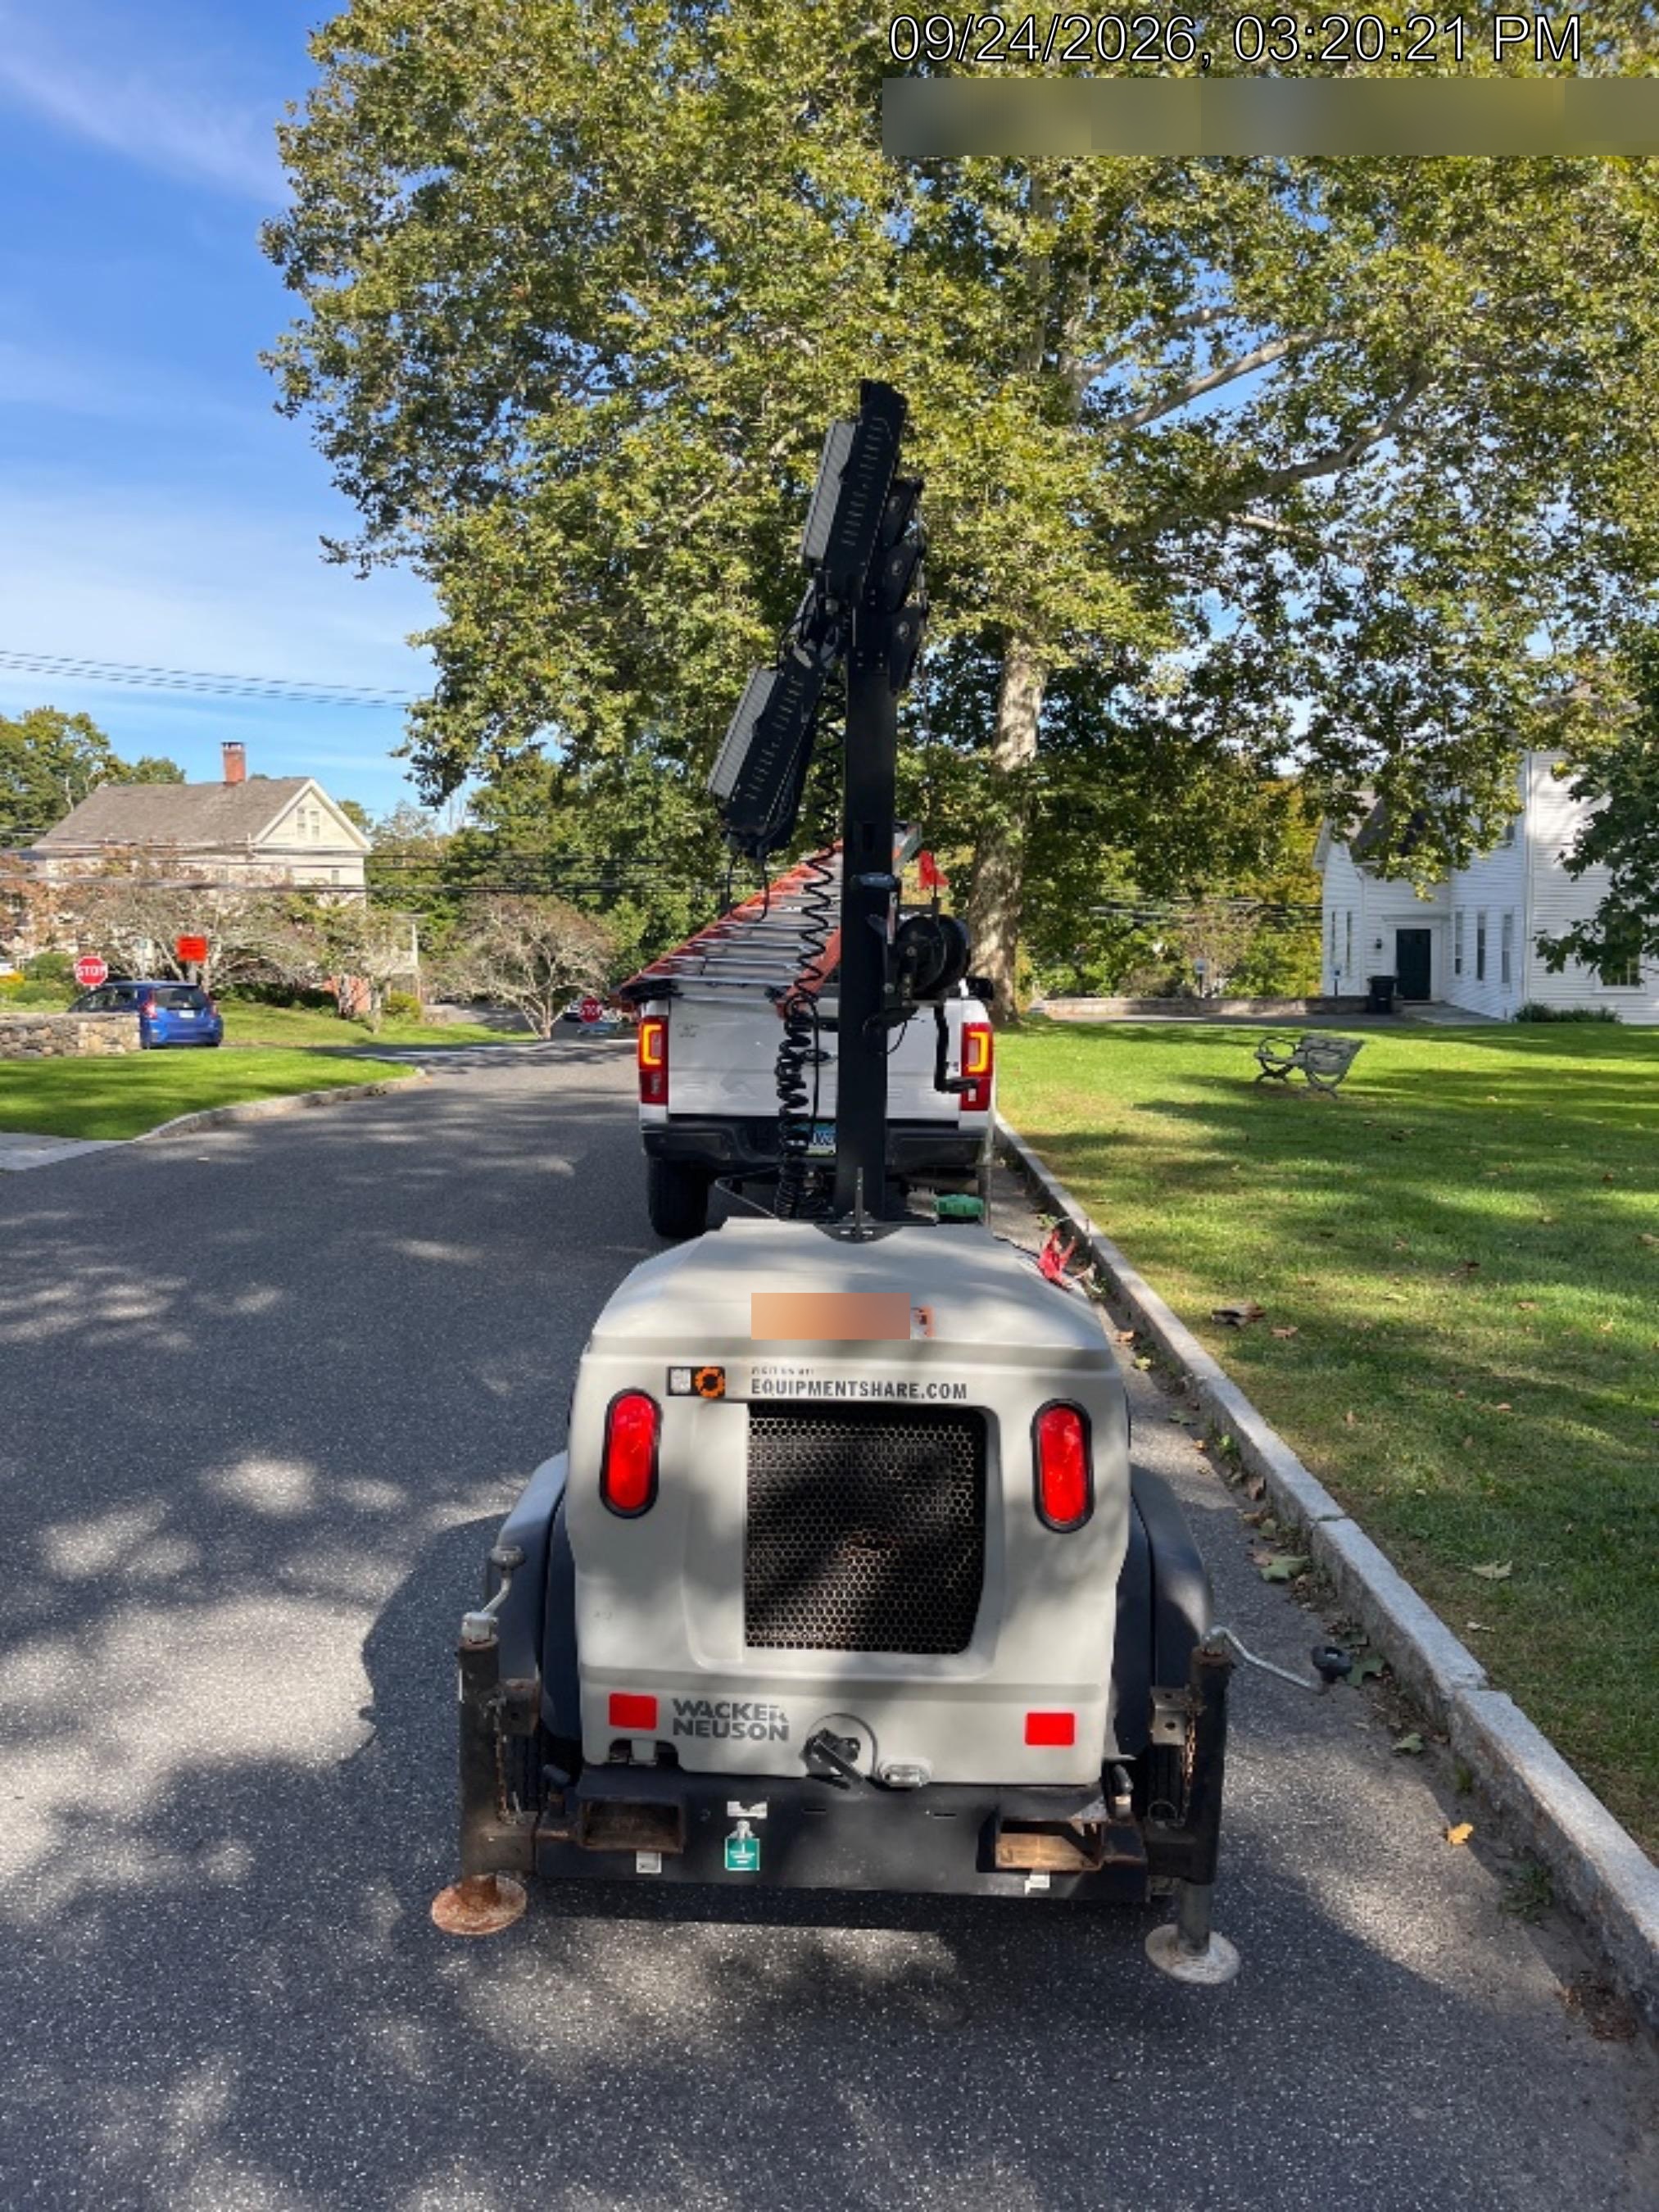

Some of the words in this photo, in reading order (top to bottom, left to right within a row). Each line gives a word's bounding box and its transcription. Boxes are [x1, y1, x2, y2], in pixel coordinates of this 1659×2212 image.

[77, 965, 107, 977] STOP
[751, 1378, 968, 1399] EQUIPMENTSHARE.COM
[672, 1698, 789, 1723] WACKER
[673, 1718, 789, 1741] NEUSON
